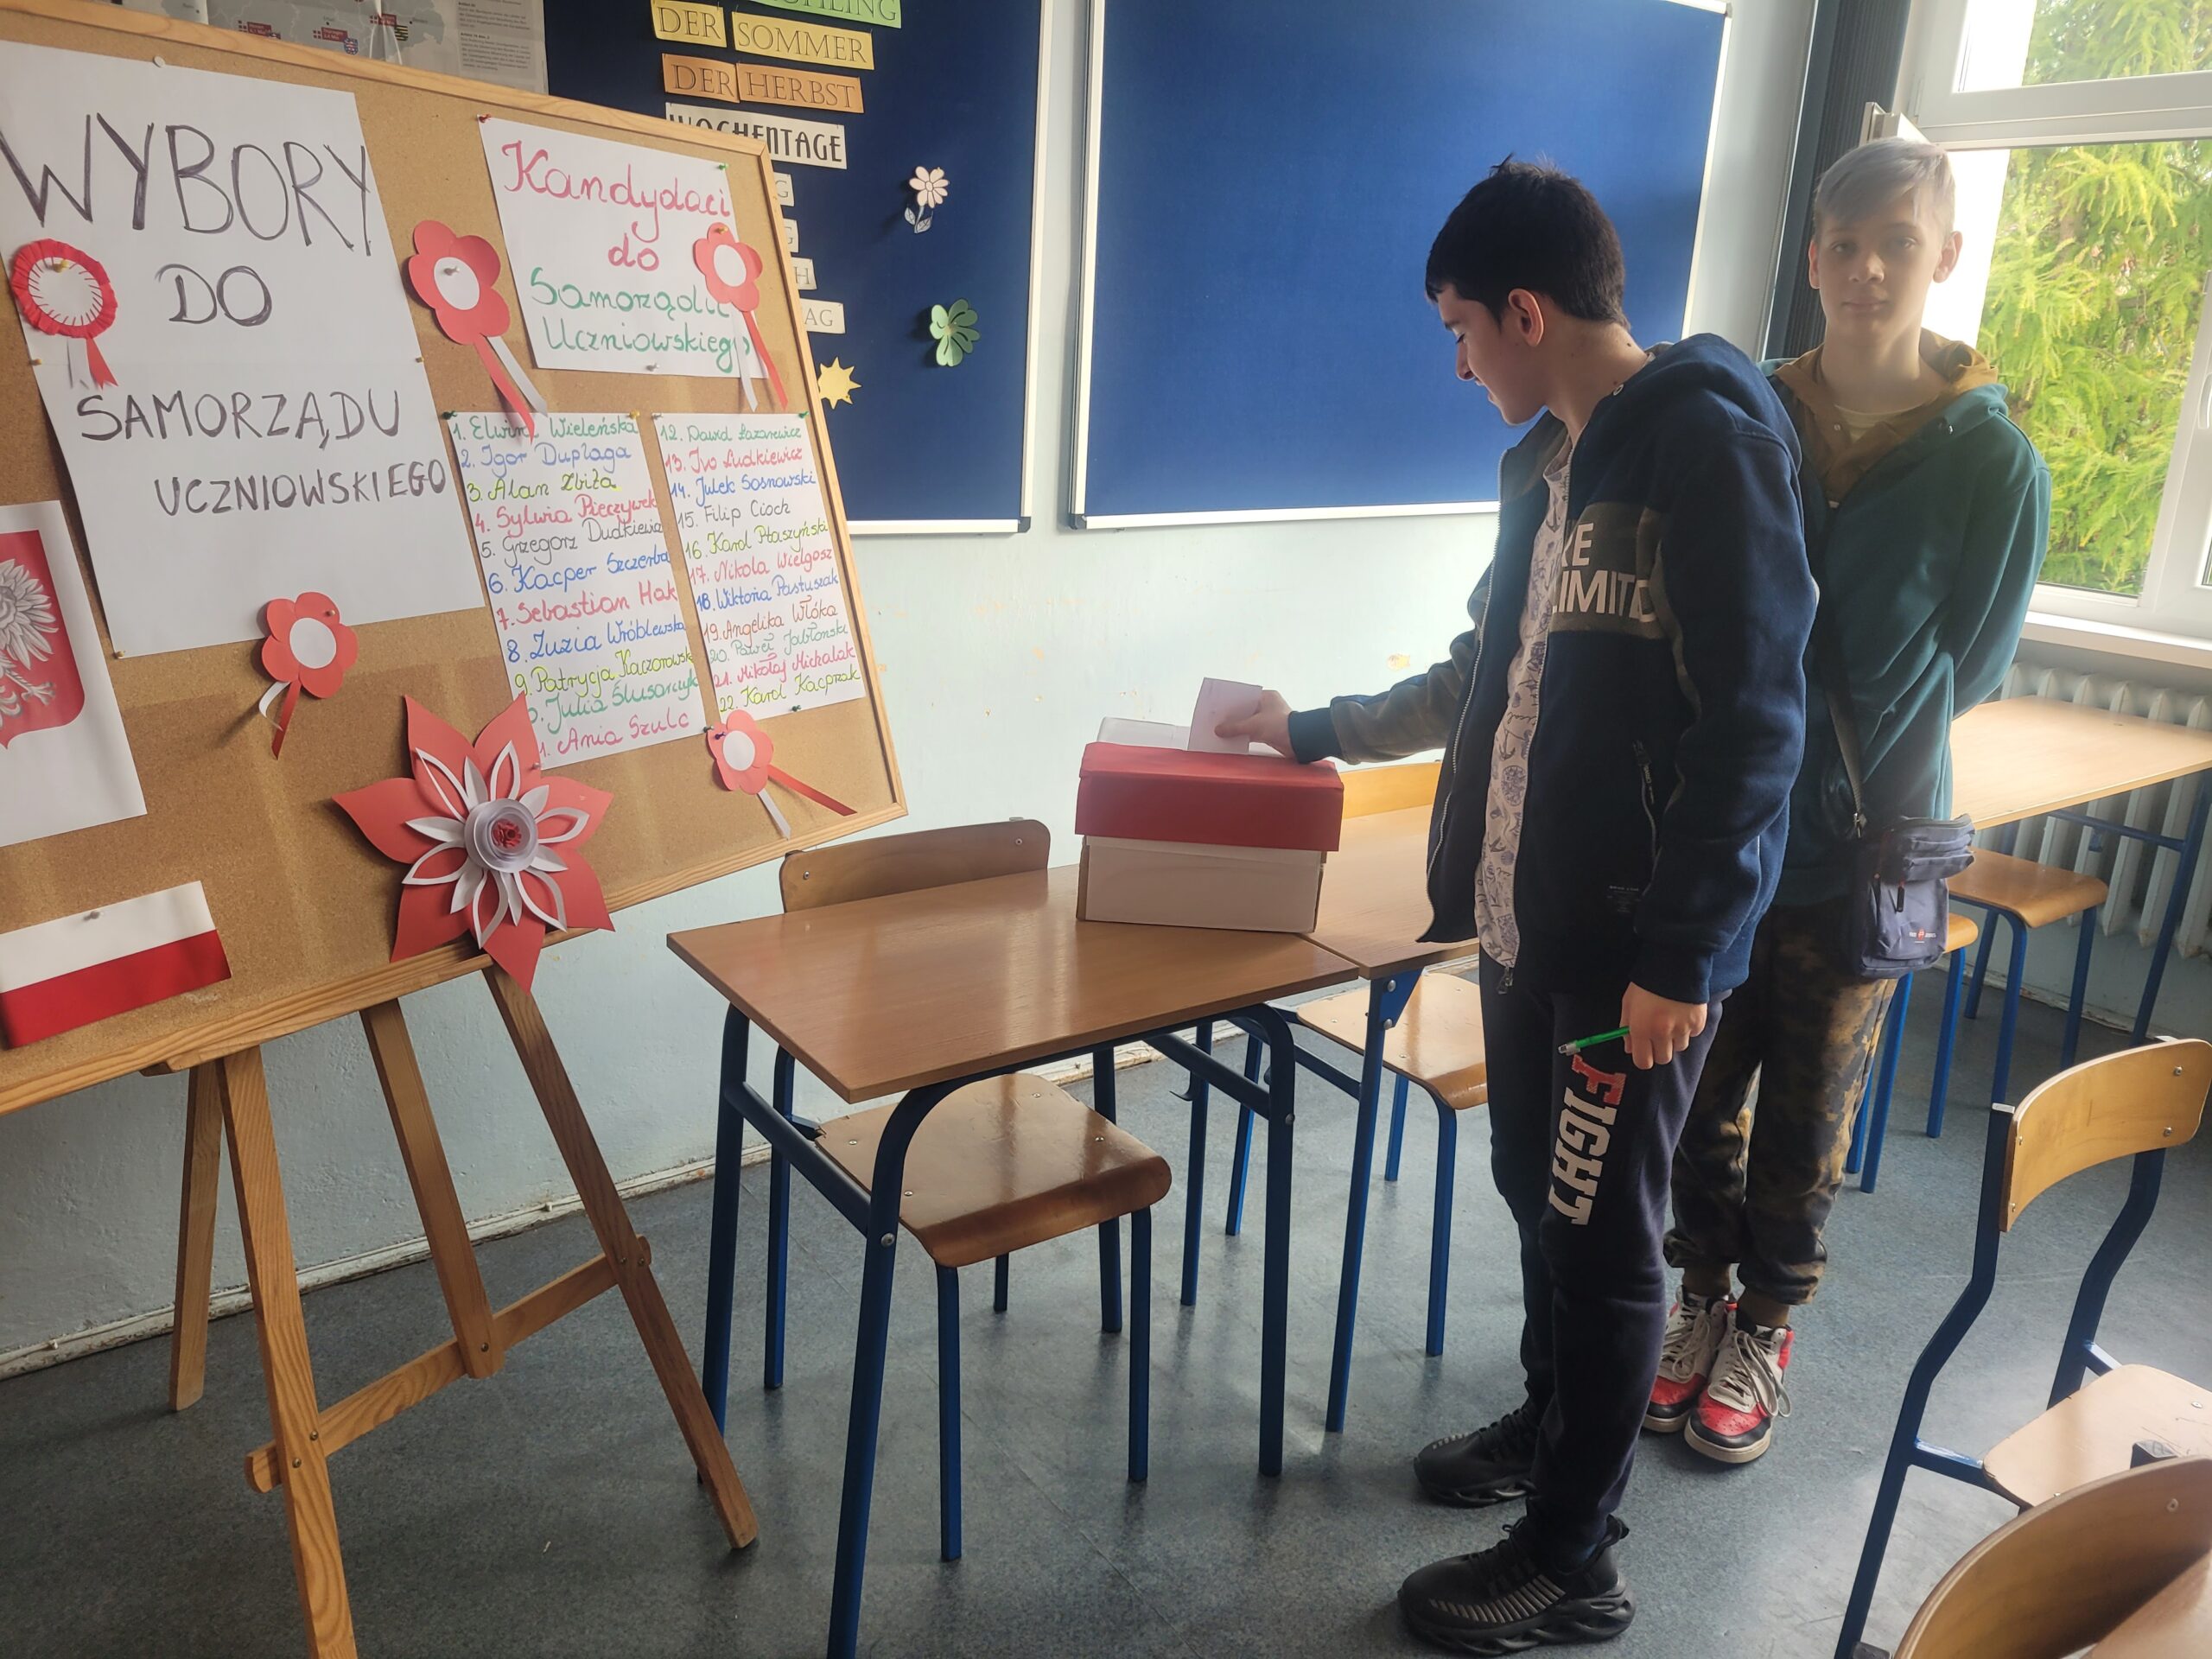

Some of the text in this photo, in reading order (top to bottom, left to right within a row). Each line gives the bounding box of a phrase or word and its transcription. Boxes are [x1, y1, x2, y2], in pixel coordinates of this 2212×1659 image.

[658, 6, 868, 63] DER SOMMER
[671, 64, 855, 108] DER HERBST
[0, 113, 371, 256] WYBORY
[502, 140, 730, 243] Kandydaci
[608, 232, 659, 271] do
[156, 263, 272, 327] DO
[77, 389, 399, 450] SAMORZĄDU
[454, 423, 466, 440] 1.
[660, 424, 683, 442] 12.
[686, 425, 732, 442] Dawid
[461, 449, 474, 467] 2.
[480, 444, 526, 478] Igor
[664, 454, 686, 474] 13.
[154, 459, 447, 516] UCZNIOWSKIEGO
[467, 483, 482, 502] 3.
[488, 478, 549, 500] Alan
[671, 468, 817, 507] 14. Julek Sosnowski
[475, 513, 490, 533] 4.
[497, 505, 572, 537] Sylwia
[677, 498, 791, 529] 15. Filip Cioch
[480, 542, 495, 558] 5.
[503, 536, 578, 568] Grzegorz
[685, 541, 708, 559] 16.
[707, 531, 752, 554] Karol
[489, 573, 507, 594] 6.
[512, 565, 596, 593] Kacper
[690, 547, 832, 585] 17. Nikola Wielgosz
[497, 607, 515, 630] 7.
[516, 590, 630, 624] Sebastian
[696, 592, 715, 612] 18.
[716, 583, 772, 609] Wiktoria
[506, 639, 527, 663] 8.
[530, 626, 601, 659] Zuzia
[703, 623, 721, 643] 19.
[723, 612, 784, 646] Angelika
[709, 649, 729, 664] 20.
[714, 641, 856, 688] 21. Mikołaj Michalak
[515, 674, 532, 696] 9.
[531, 665, 614, 698] Patrycja
[720, 664, 861, 712] 22. Karol Kacprzak
[528, 708, 543, 723] 0.
[545, 692, 607, 734] Julia
[540, 707, 689, 757] 1. Ania Szulc
[1548, 1054, 1627, 1225] FIGHT
